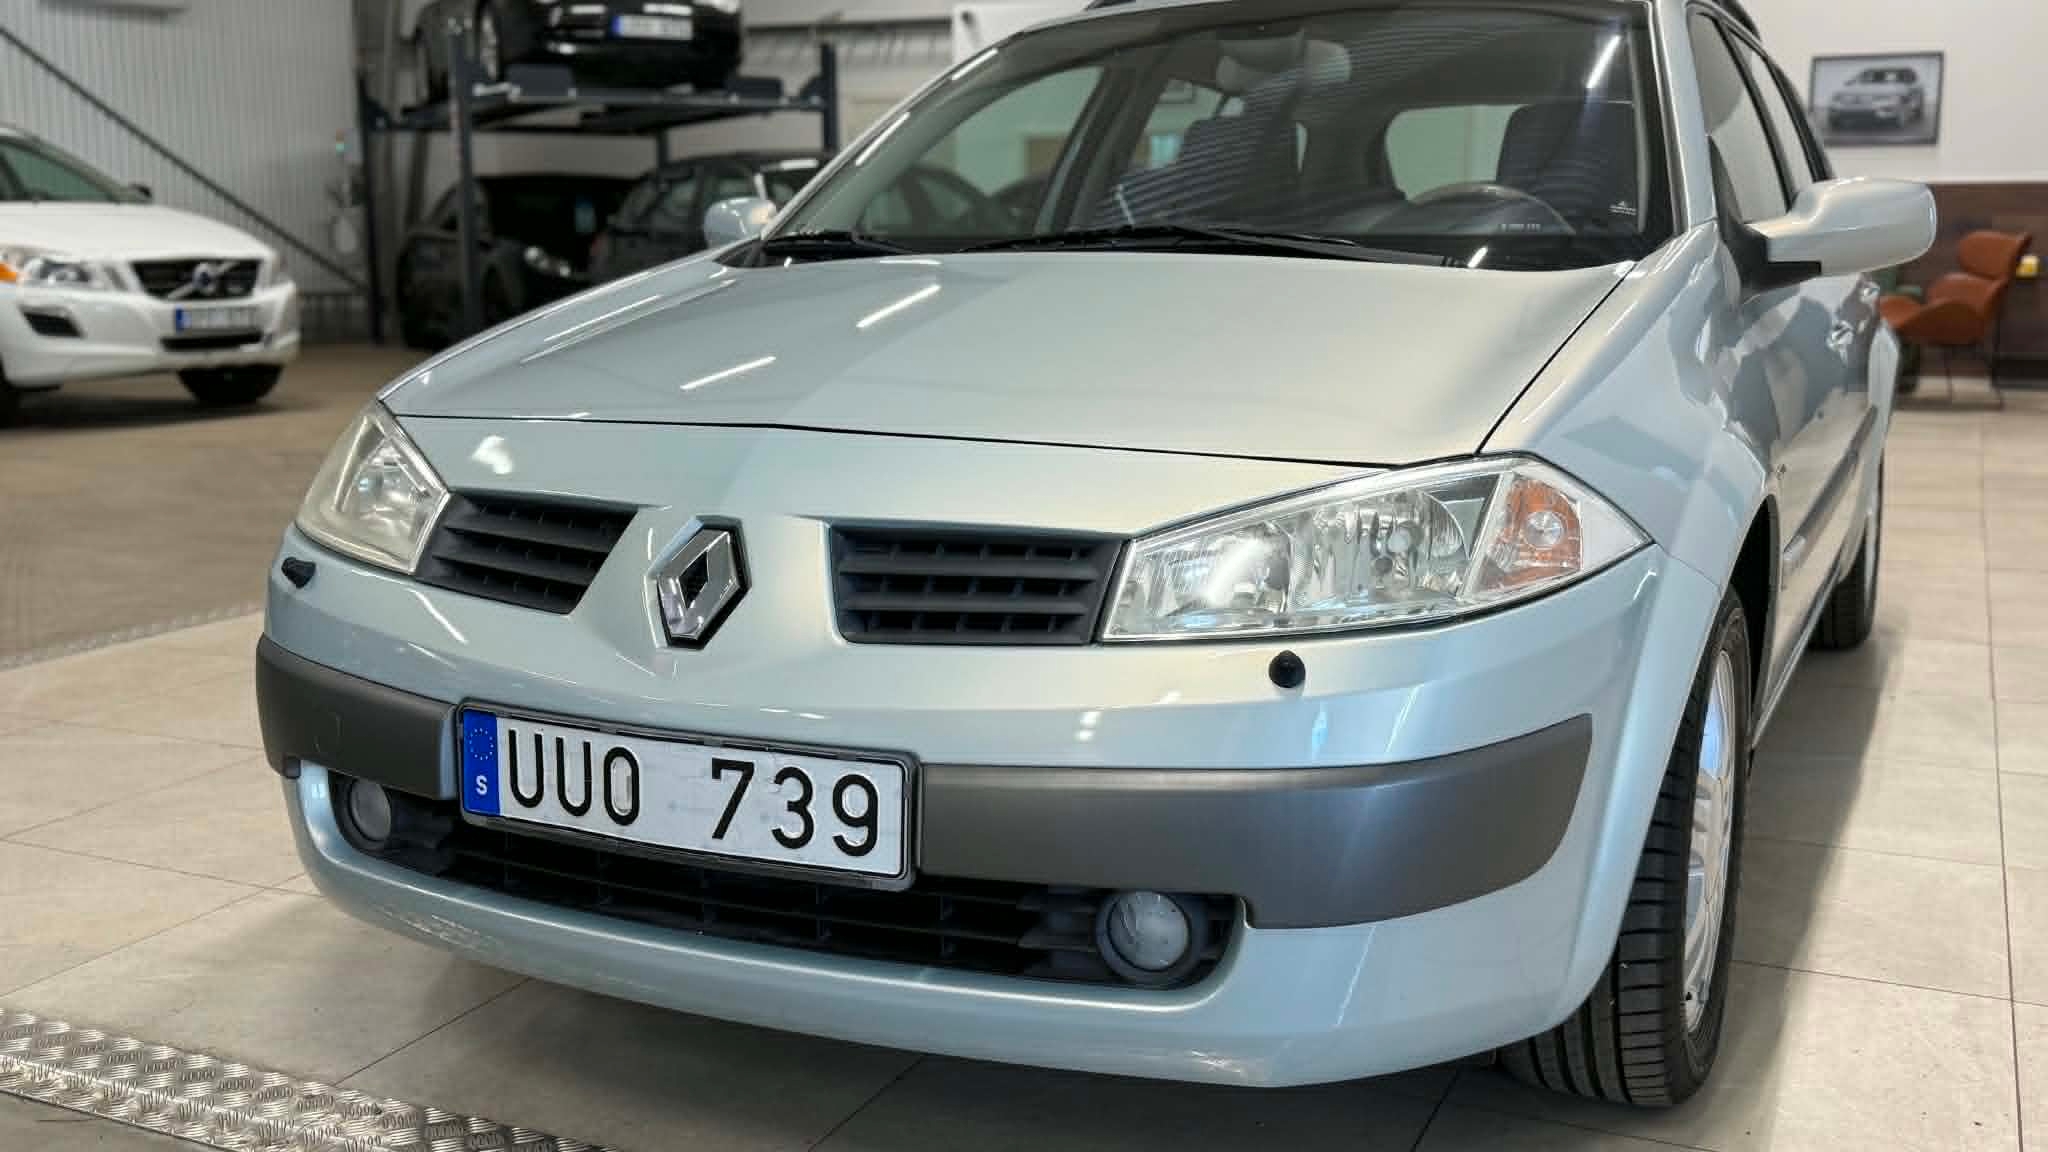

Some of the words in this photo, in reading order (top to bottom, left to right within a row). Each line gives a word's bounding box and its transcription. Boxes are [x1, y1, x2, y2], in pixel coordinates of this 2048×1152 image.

[475, 775, 488, 796] S
[508, 729, 640, 826] UUO
[711, 757, 879, 857] 739
